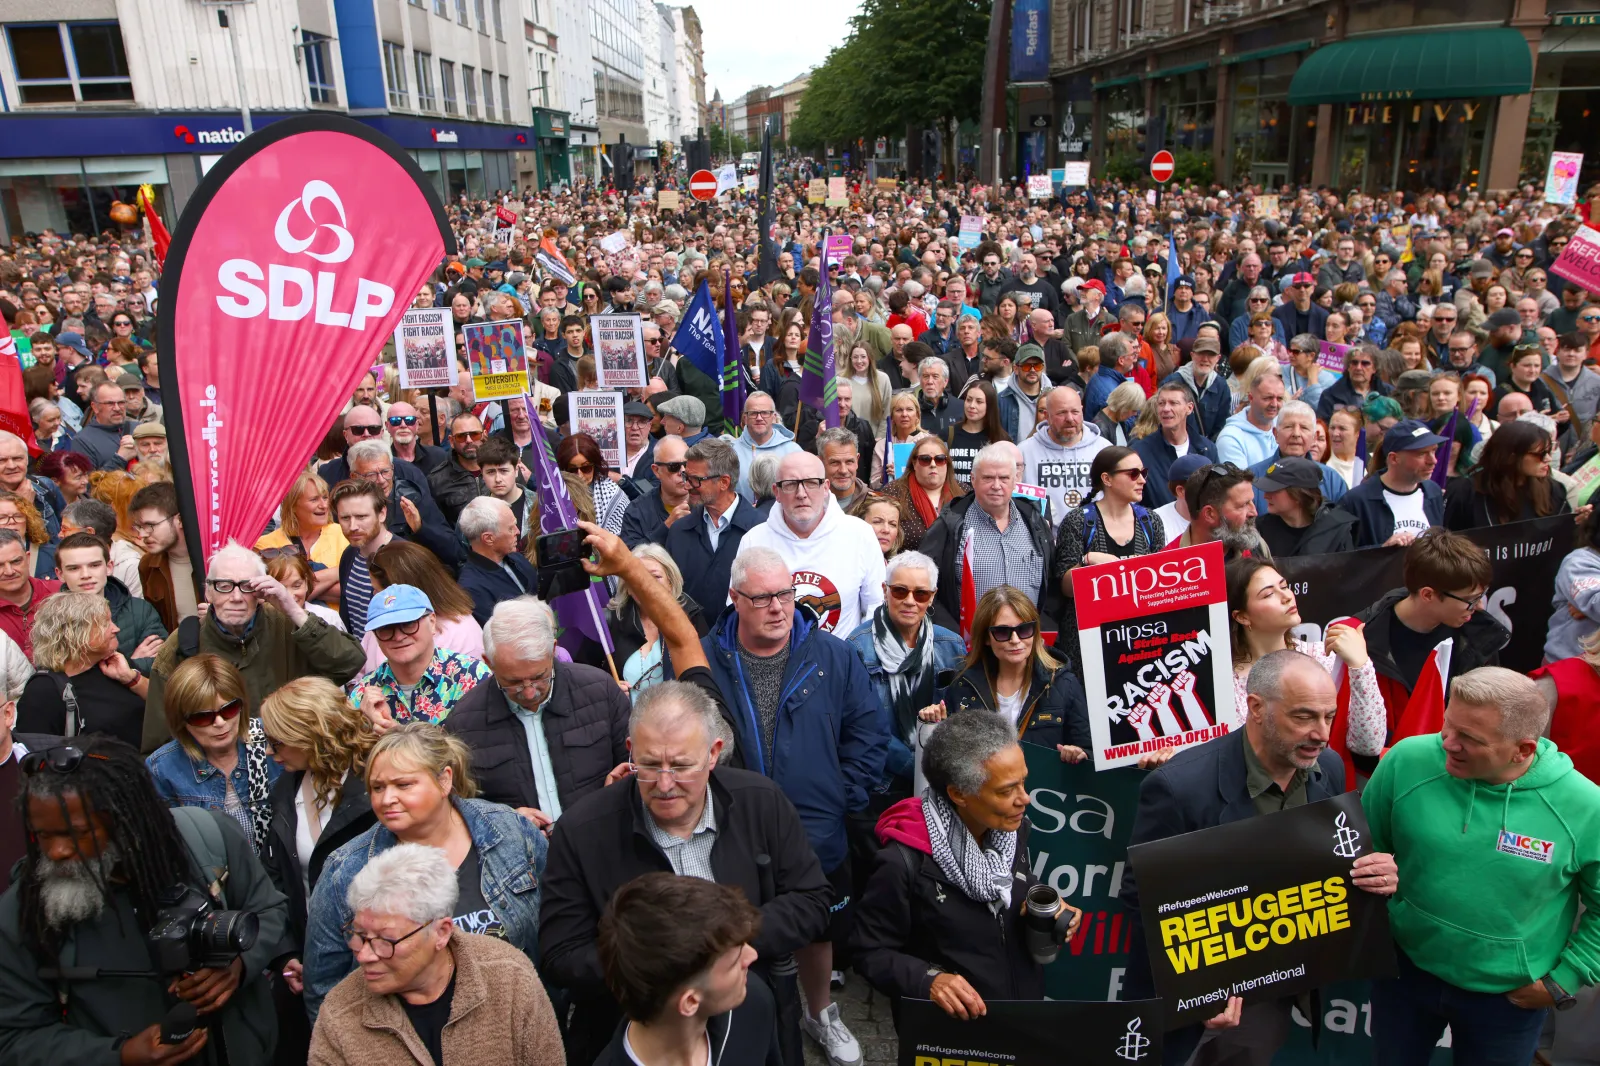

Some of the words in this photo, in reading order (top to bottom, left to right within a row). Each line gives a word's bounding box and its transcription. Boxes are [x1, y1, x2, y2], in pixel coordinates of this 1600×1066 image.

[1026, 9, 1038, 56] Belfast
[1347, 105, 1392, 125] THE
[1412, 103, 1480, 123] IVY
[216, 258, 396, 331] SDLP
[402, 314, 419, 324] FIGHT
[419, 313, 443, 323] FASCISM
[599, 319, 613, 328] FIGHT
[613, 319, 633, 328] FASCISM
[403, 327, 420, 337] FIGHT
[421, 325, 444, 336] RACISM
[600, 331, 614, 340] FIGHT
[614, 331, 634, 340] RACISM
[688, 324, 701, 341] The
[407, 369, 433, 380] WORKERS
[433, 368, 449, 379] UNITE
[484, 374, 519, 385] DIVERSITY
[604, 370, 625, 379] WORKERS
[625, 370, 639, 379] UNITE
[577, 397, 592, 406] FIGHT
[592, 396, 615, 406] FASCISM
[578, 408, 594, 418] FIGHT
[595, 408, 616, 418] RACISM
[604, 450, 619, 459] UNITE
[1394, 519, 1430, 531] FUGEE
[1496, 545, 1508, 561] is
[1514, 537, 1553, 559] illegal
[793, 572, 822, 585] ATE
[1091, 556, 1208, 608] nipsa
[1140, 590, 1165, 600] Protecting
[1165, 587, 1180, 596] Public
[1180, 584, 1199, 593] Services
[1147, 596, 1174, 607] Supporting
[1174, 594, 1189, 602] Public
[1189, 590, 1209, 599] Servants
[1106, 620, 1168, 651] nipsa
[1133, 635, 1168, 650] Strike
[1170, 629, 1198, 643] Back
[1118, 647, 1163, 665] Against
[1106, 629, 1212, 725] RACISM
[1104, 723, 1230, 761] www.nipsa.org.uk
[1503, 832, 1553, 854] NICCY
[1158, 884, 1249, 914] #RefugeesWelcome
[1159, 876, 1347, 948] REFUGEES
[1165, 902, 1351, 975] WELCOME
[1177, 987, 1230, 1012] Amnesty
[1232, 963, 1306, 995] International
[916, 1044, 1016, 1061] #RefugeesWelcome
